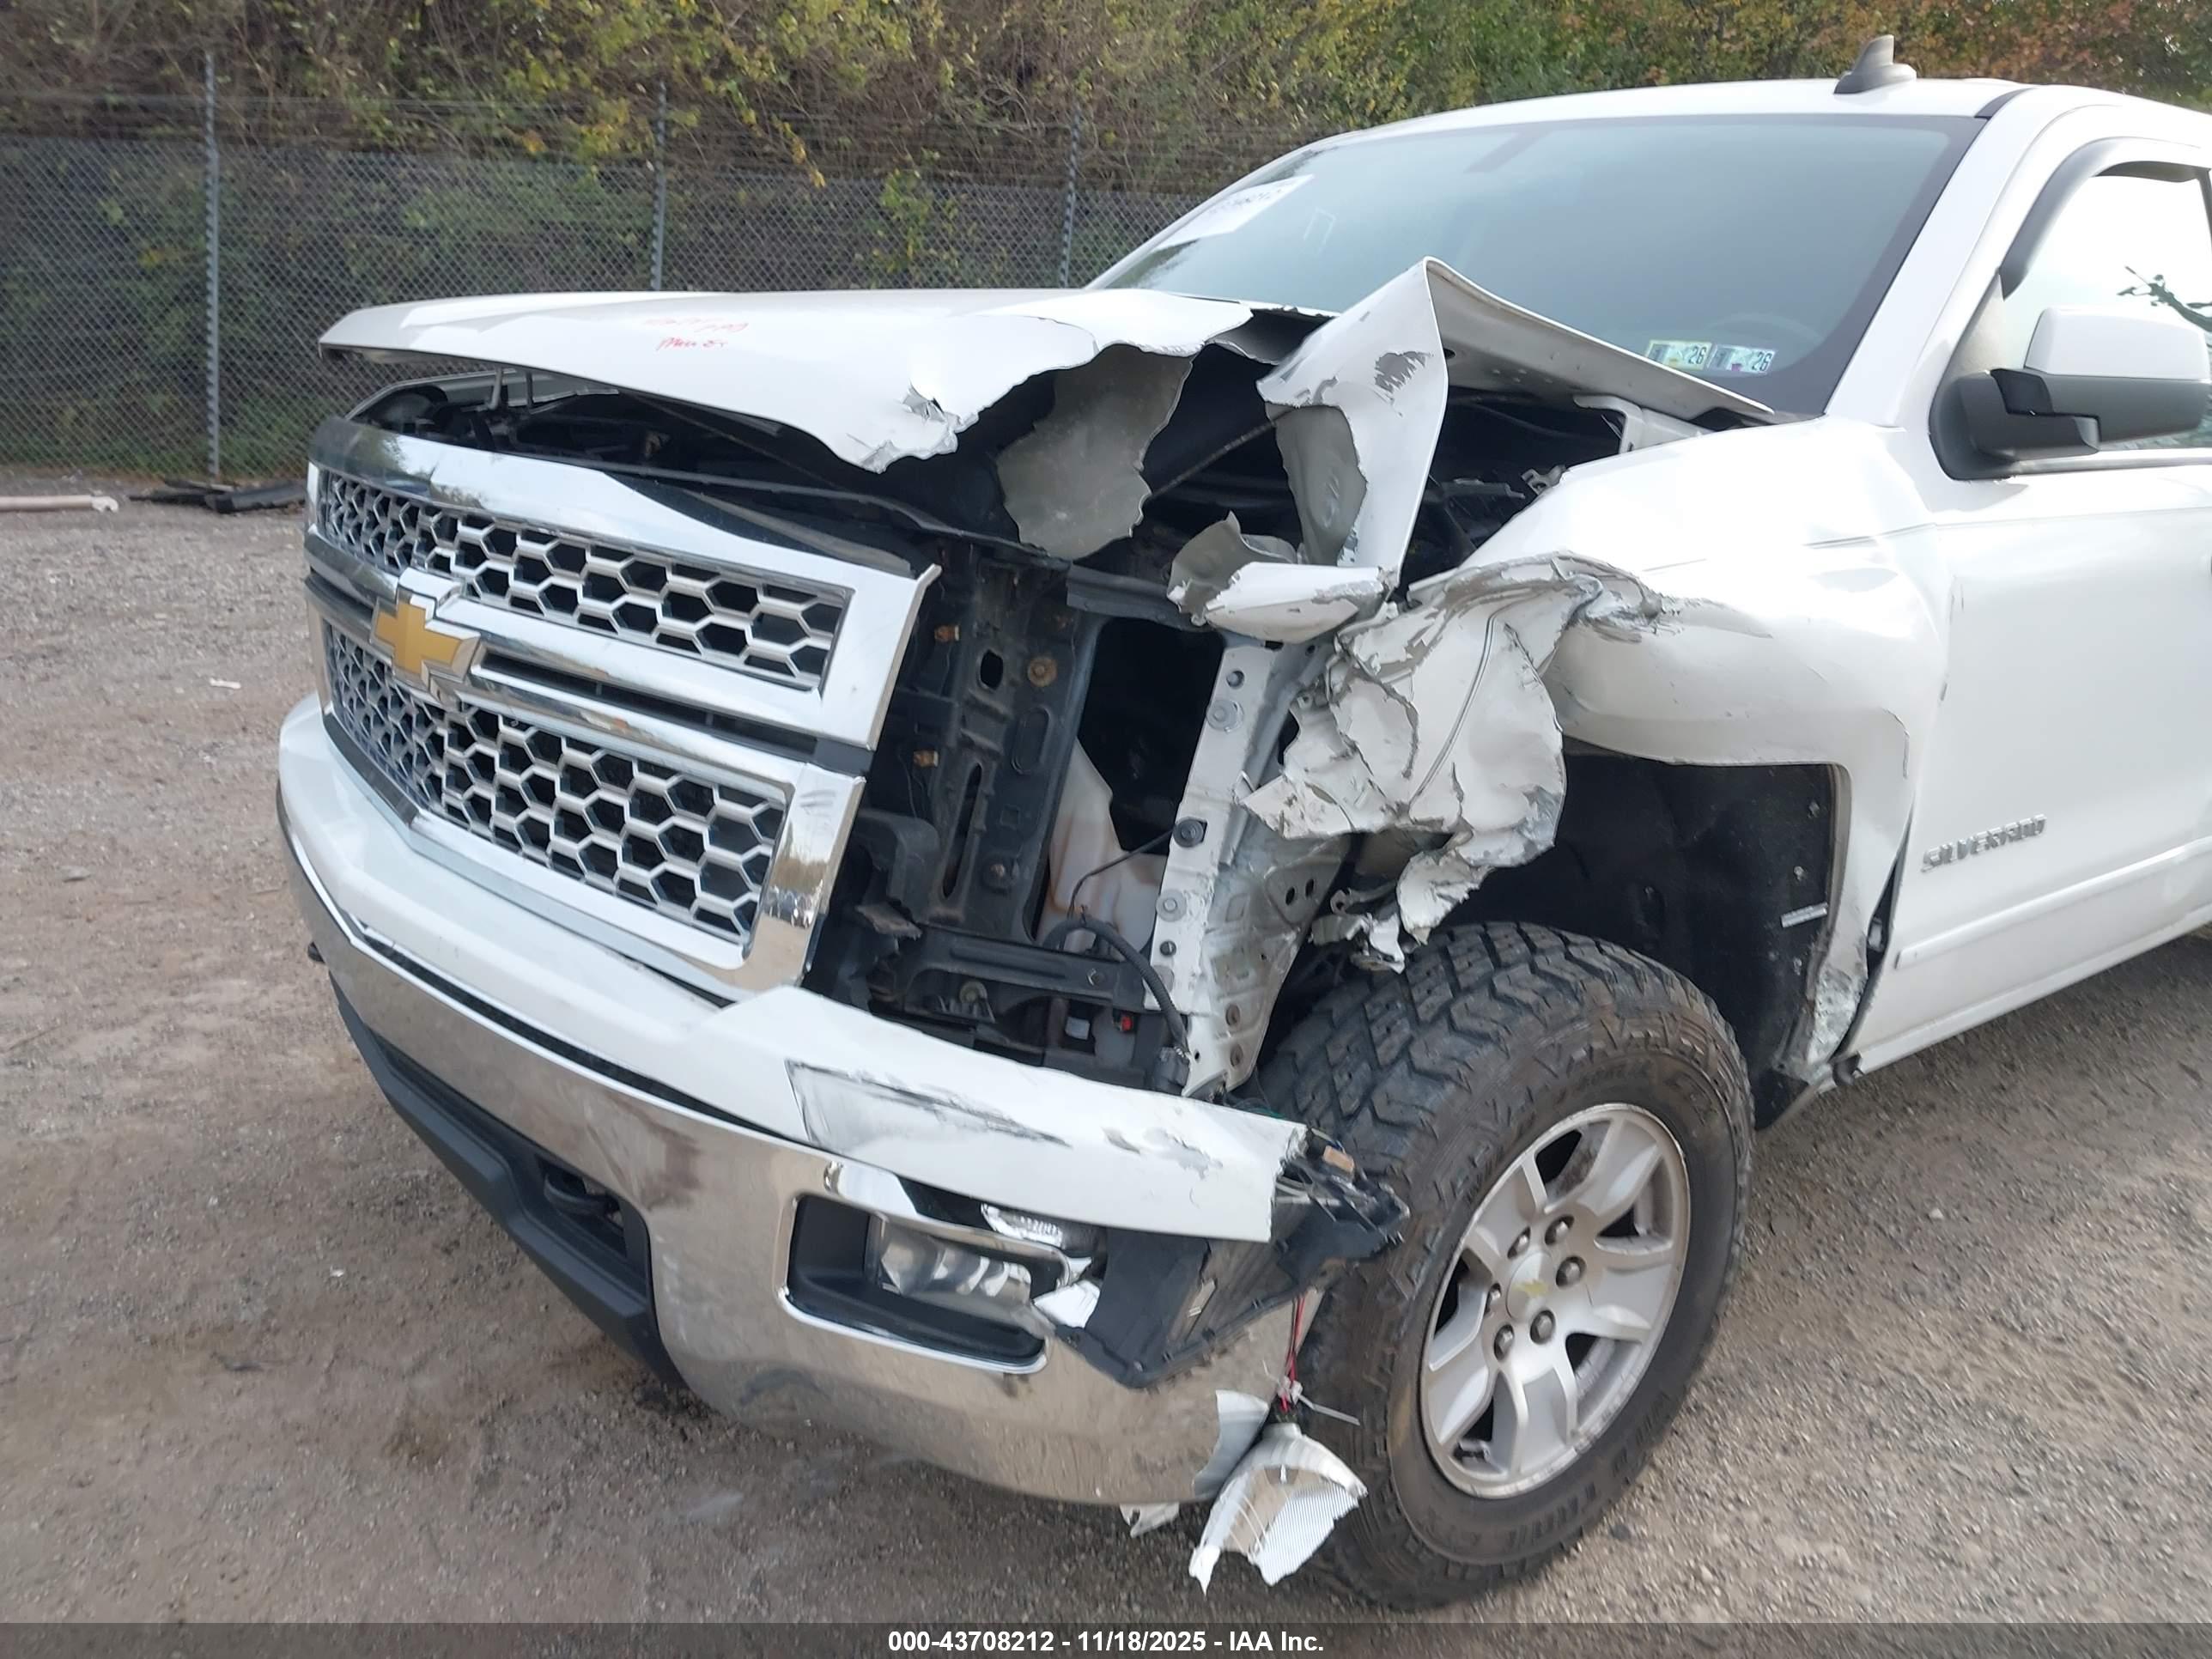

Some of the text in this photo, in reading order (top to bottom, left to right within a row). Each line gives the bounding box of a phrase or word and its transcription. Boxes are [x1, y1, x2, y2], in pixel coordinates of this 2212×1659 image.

[1687, 345, 1707, 365] 26
[1751, 350, 1772, 372] 26
[1922, 814, 2047, 872] SILVERADO
